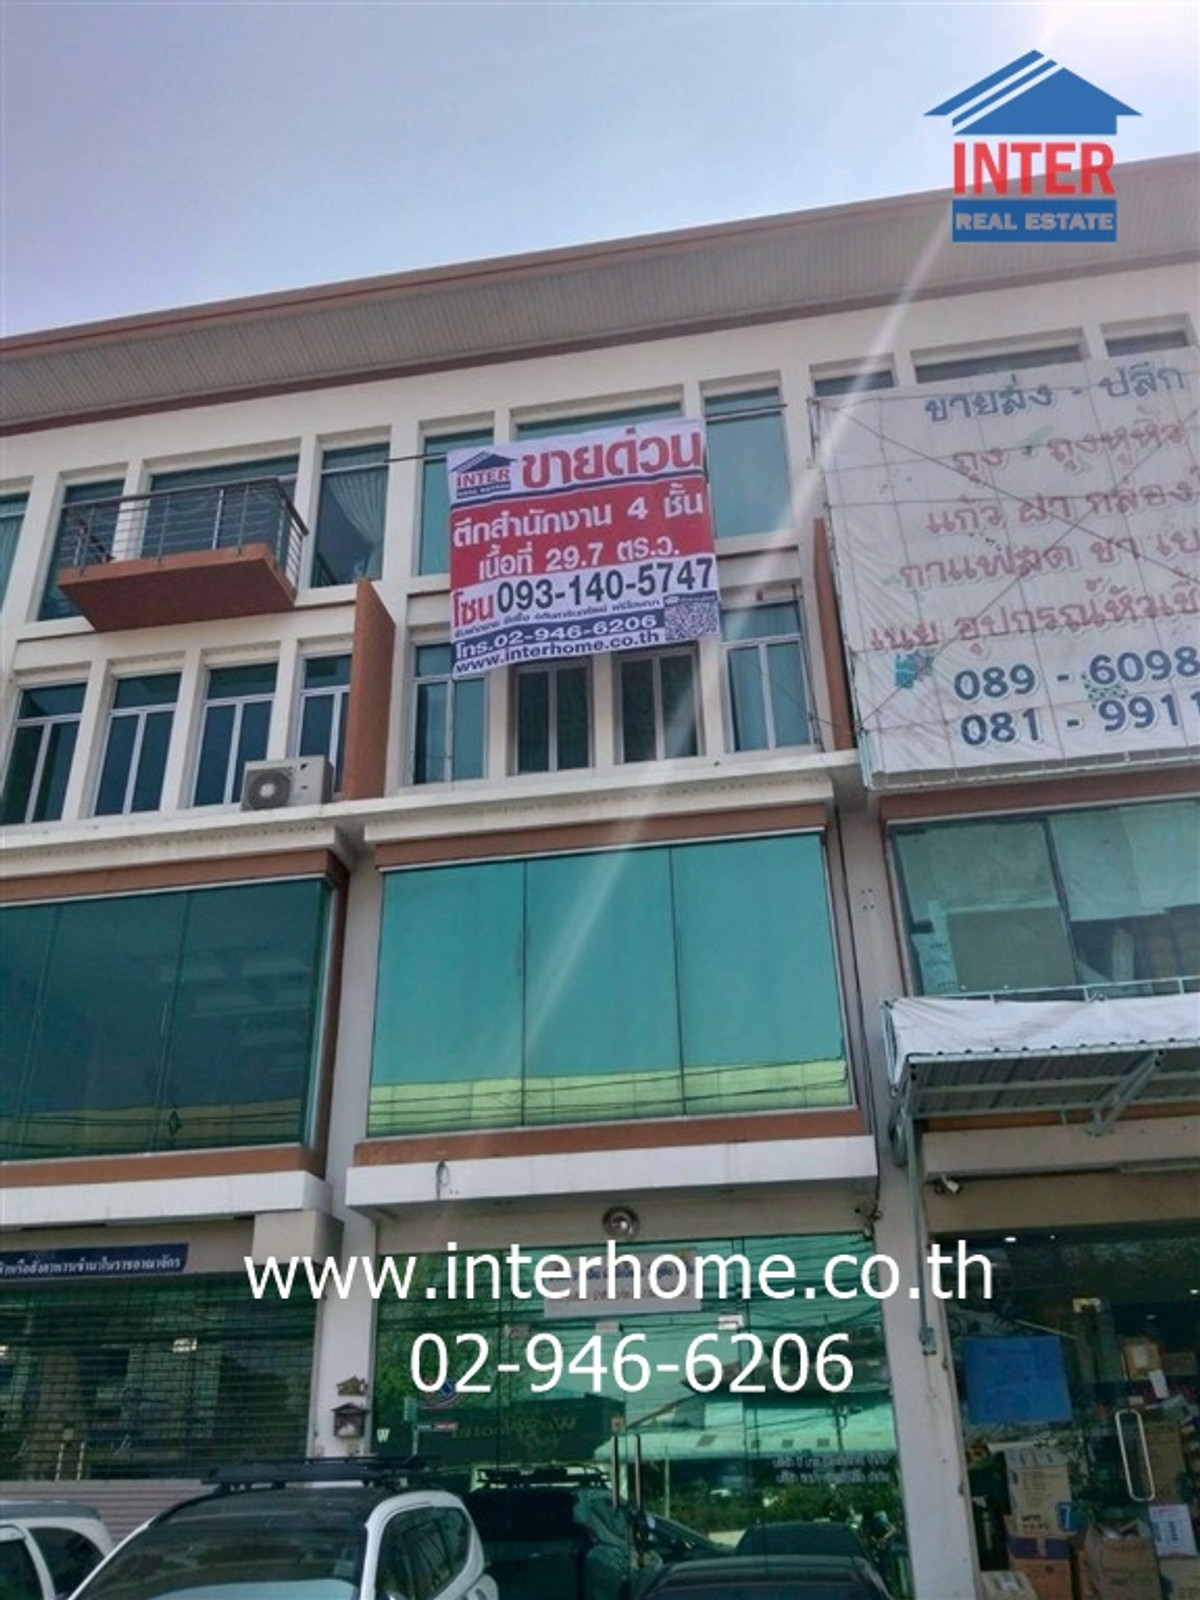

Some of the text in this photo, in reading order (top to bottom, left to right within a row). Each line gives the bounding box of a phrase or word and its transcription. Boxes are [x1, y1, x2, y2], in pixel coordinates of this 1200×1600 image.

[924, 374, 1053, 422] ขายส่ง
[1100, 361, 1186, 398] ปลีก
[457, 468, 511, 488] INTER
[521, 428, 702, 489] ขายด่วน
[453, 483, 704, 548] ตึกสำนักงาน 4 ชั้น
[478, 536, 681, 580] เนื้อที่ 29.7 ตร.ว.
[497, 556, 714, 615] 093-140-5747
[456, 630, 661, 673] www.interhome.co.th
[953, 663, 1037, 702] 089
[1089, 646, 1200, 686] 6098
[960, 707, 1041, 747] 081
